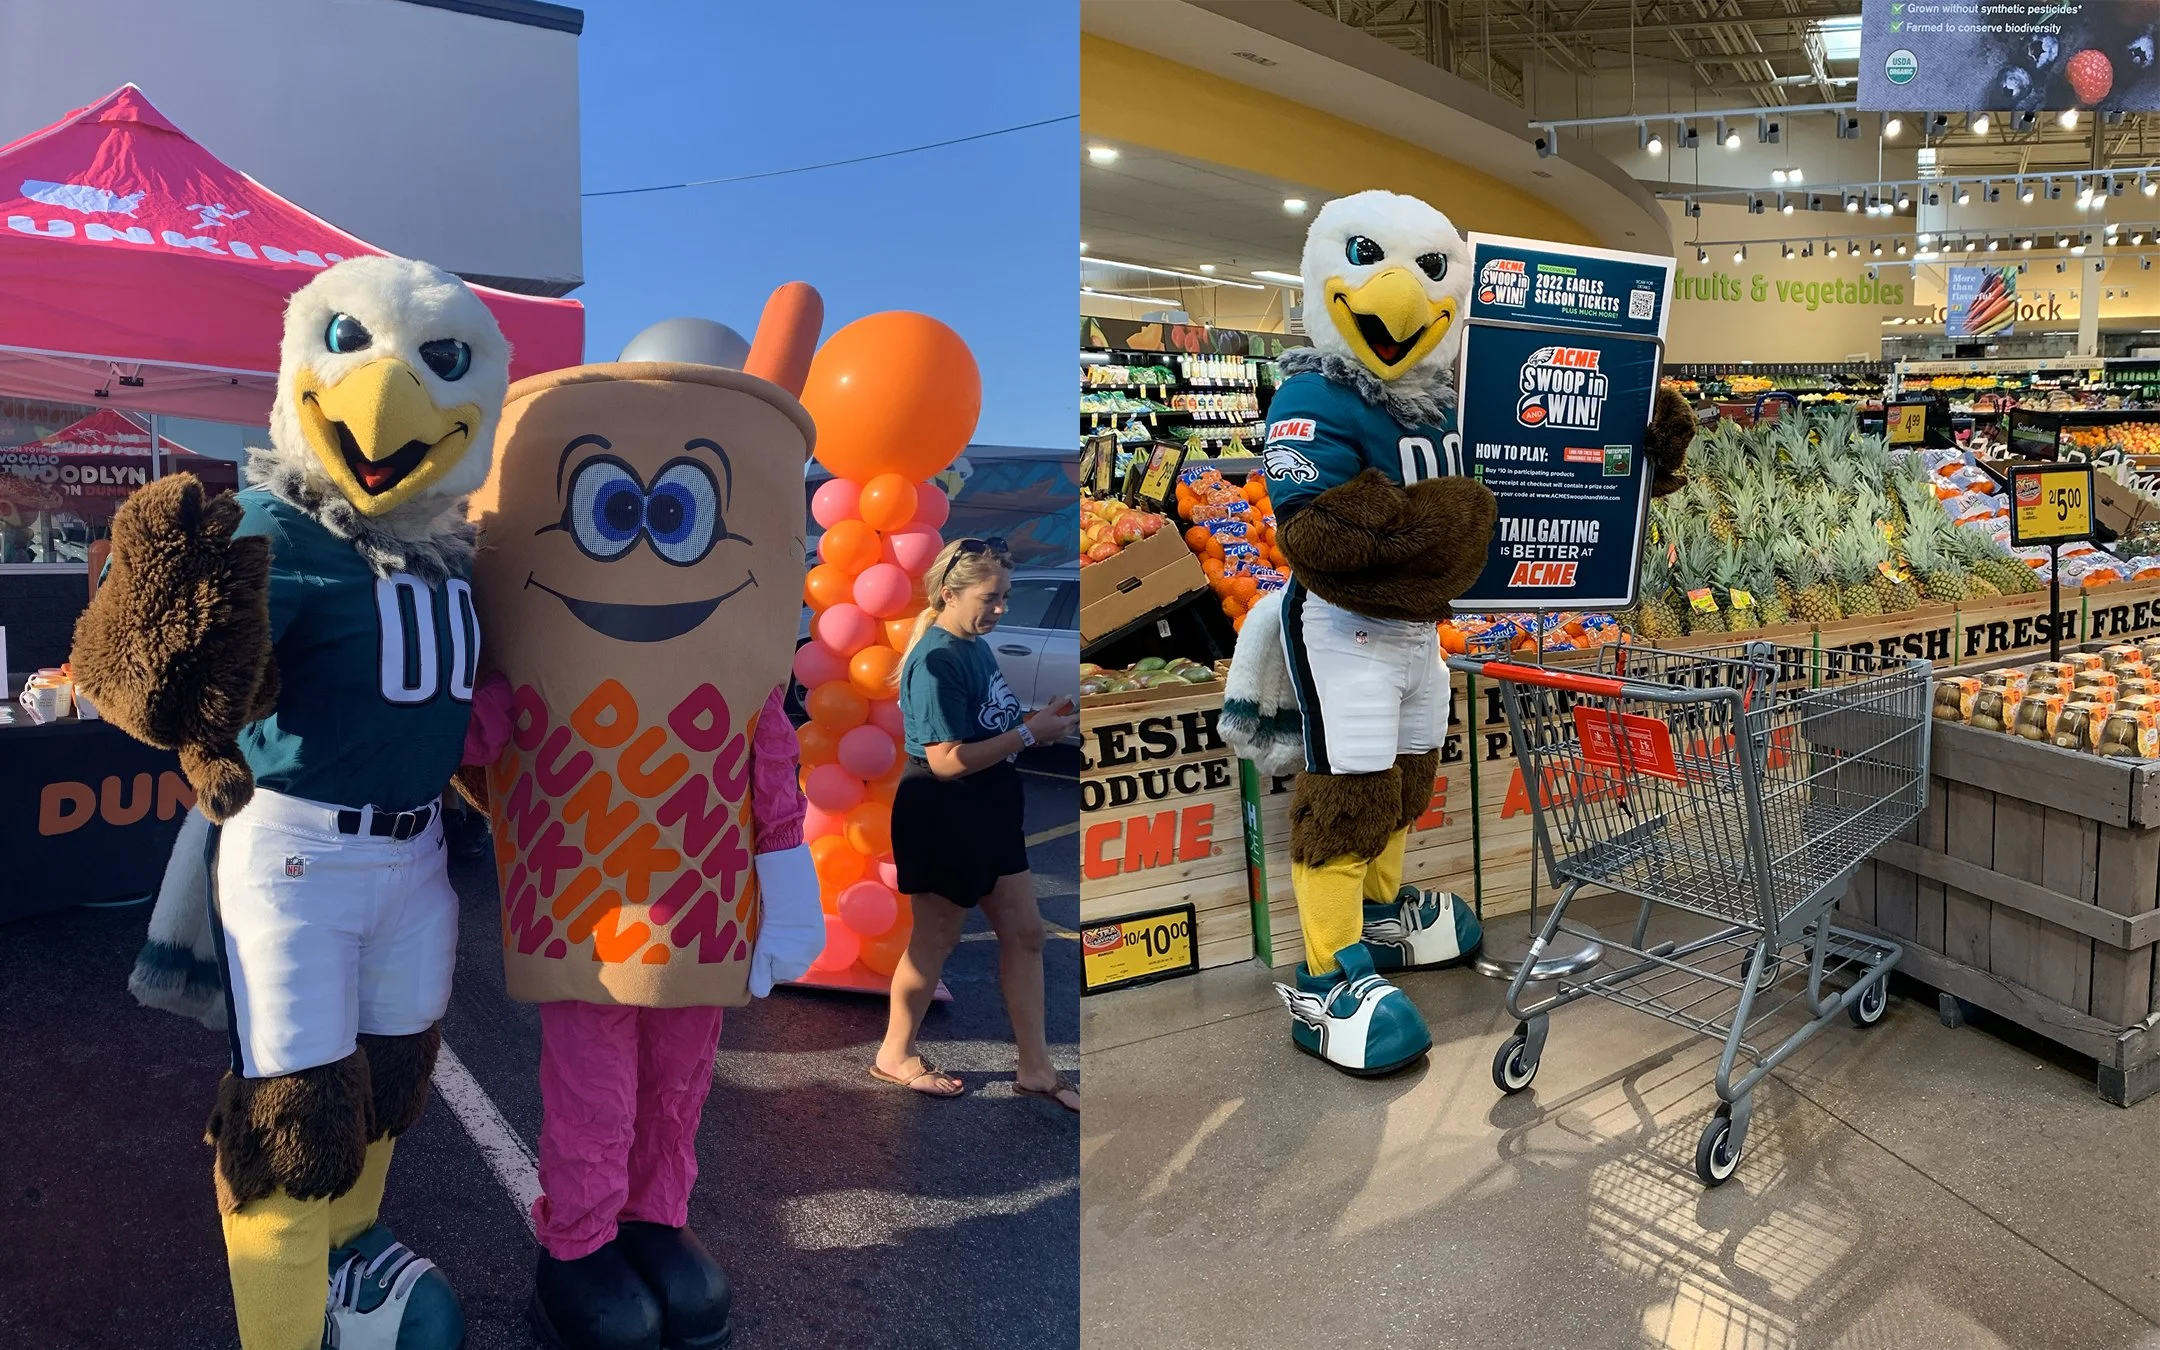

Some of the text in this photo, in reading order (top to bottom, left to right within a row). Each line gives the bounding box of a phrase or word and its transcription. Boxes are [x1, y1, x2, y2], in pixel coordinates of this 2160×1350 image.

[1907, 4, 1940, 14] Grown
[1943, 4, 1978, 14] without
[1981, 4, 2025, 16] synthetic
[1906, 23, 2061, 35] Farmed to conserve biodiversity
[1892, 57, 1911, 66] USDA
[1889, 67, 1913, 75] ORGANIC
[1499, 260, 1524, 272] ACME
[1482, 271, 1528, 288] SWOOP in
[1536, 273, 1604, 295] 2022 EAGLES
[1952, 274, 1976, 283] More
[1952, 282, 1974, 291] than
[1495, 285, 1524, 305] WIN!
[1673, 268, 1904, 312] fruits & vegetables
[1534, 289, 1620, 311] SEASON TICKETS
[1161, 312, 1169, 323] 4
[1561, 307, 1578, 315] PLUS
[1579, 309, 1598, 317] MUCH
[2013, 299, 2063, 321] lock
[1552, 348, 1599, 369] ACME
[1524, 367, 1605, 396] SWOOP in
[1526, 411, 1543, 419] AND
[1548, 393, 1598, 426] WIN!
[1270, 421, 1307, 439] ACME
[1475, 443, 1549, 462] HOW TO PLAY:
[1513, 469, 1550, 477] participating
[1499, 517, 1600, 543] TAILGATING
[1500, 544, 1594, 559] IS BETTER AT
[1508, 562, 1575, 586] ACME
[1964, 607, 2077, 658] FRESH
[287, 864, 304, 876] NFL
